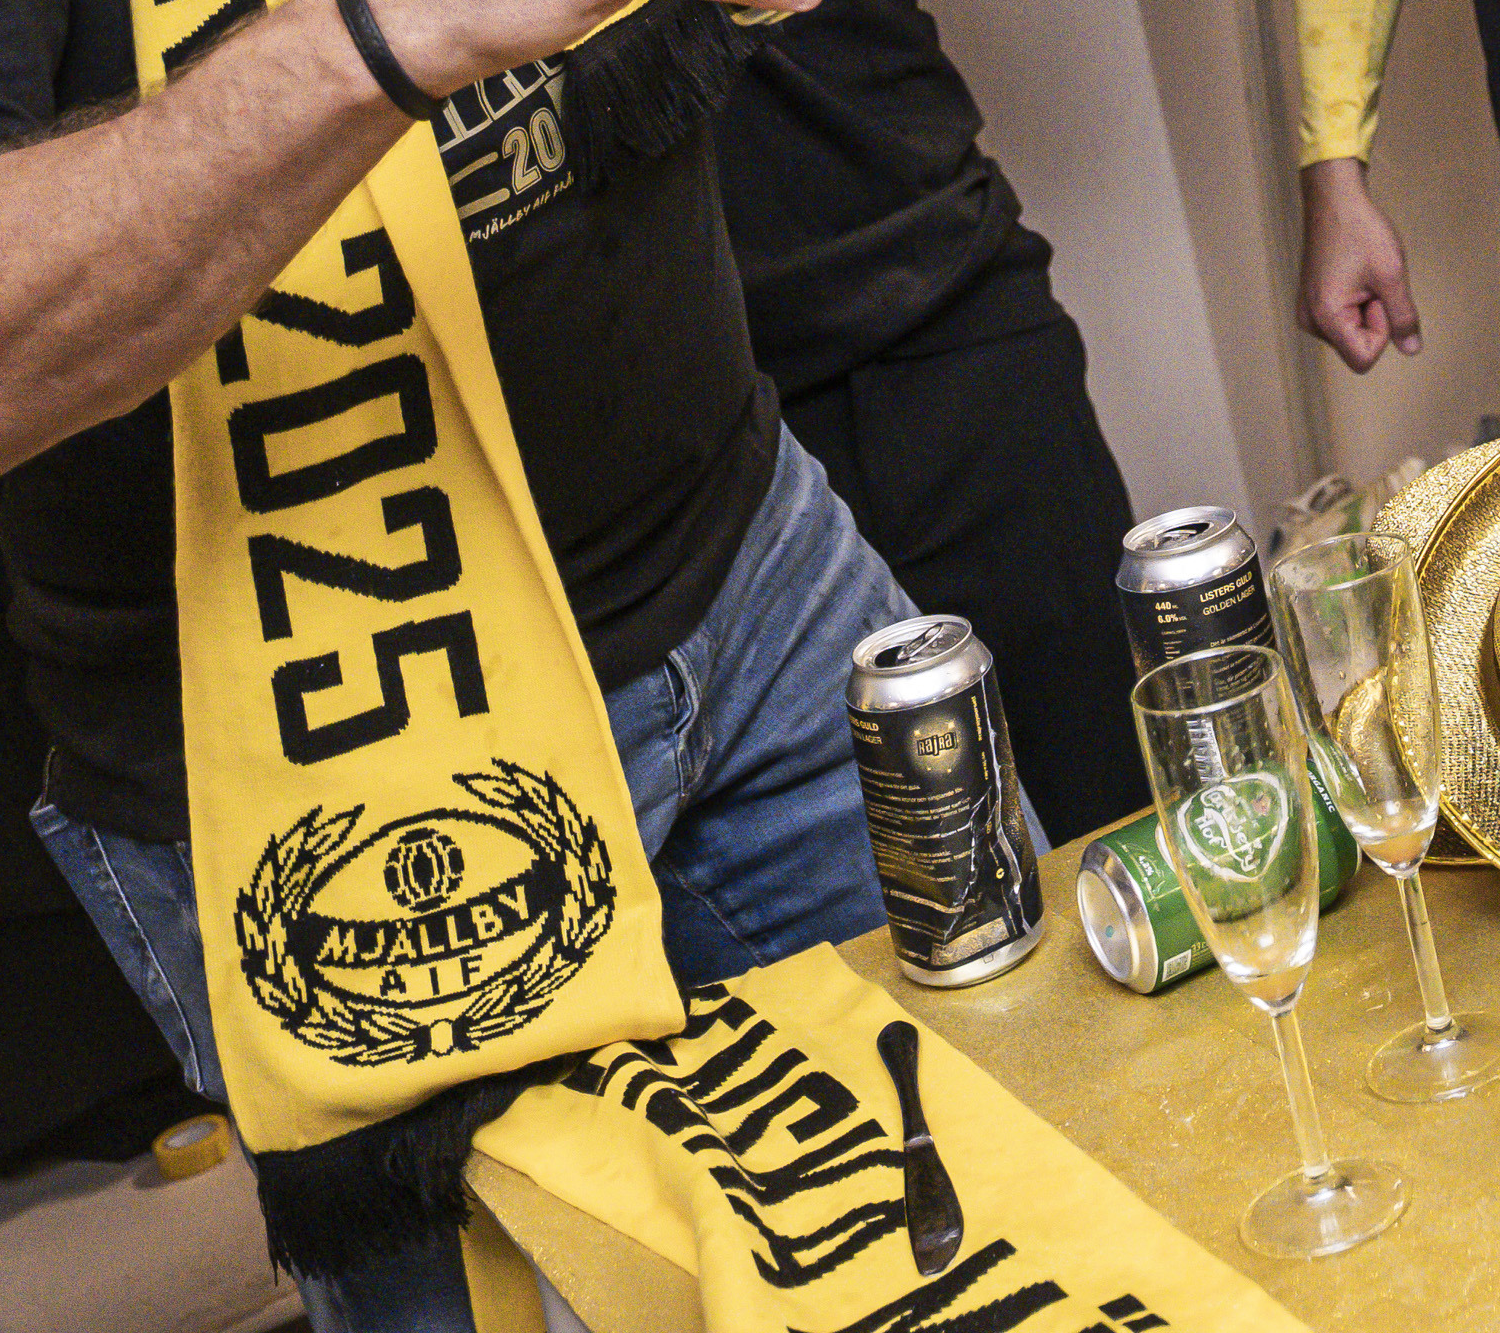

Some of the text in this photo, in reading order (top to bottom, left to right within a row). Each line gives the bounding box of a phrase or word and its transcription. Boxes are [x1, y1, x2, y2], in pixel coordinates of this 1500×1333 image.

[501, 106, 566, 195] 20
[468, 203, 531, 243] MJÄLLBY
[214, 225, 492, 769] 2025
[1154, 600, 1172, 612] 440
[1199, 582, 1235, 604] LISTERS
[1202, 583, 1256, 617] GOLDEN LAGER
[316, 885, 532, 965] MJÄLLBY
[379, 954, 484, 998] AIF
